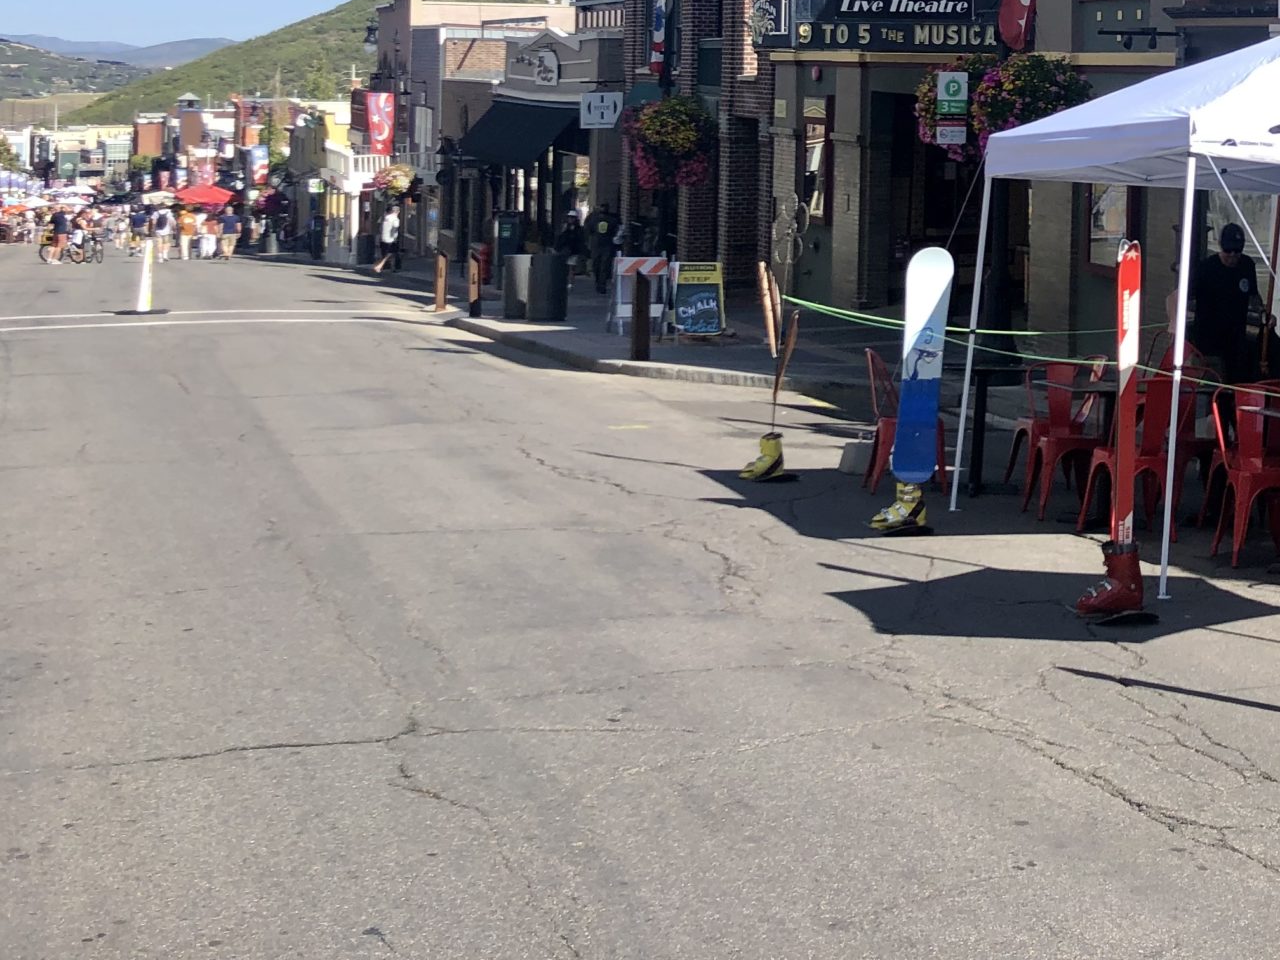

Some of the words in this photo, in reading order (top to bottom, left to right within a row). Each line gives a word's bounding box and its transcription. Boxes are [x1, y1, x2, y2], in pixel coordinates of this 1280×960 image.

[799, 22, 812, 44] 9
[821, 23, 849, 44] TO
[858, 23, 871, 45] 5
[881, 28, 905, 43] THE
[914, 24, 997, 46] MUSICA
[941, 101, 949, 112] 3
